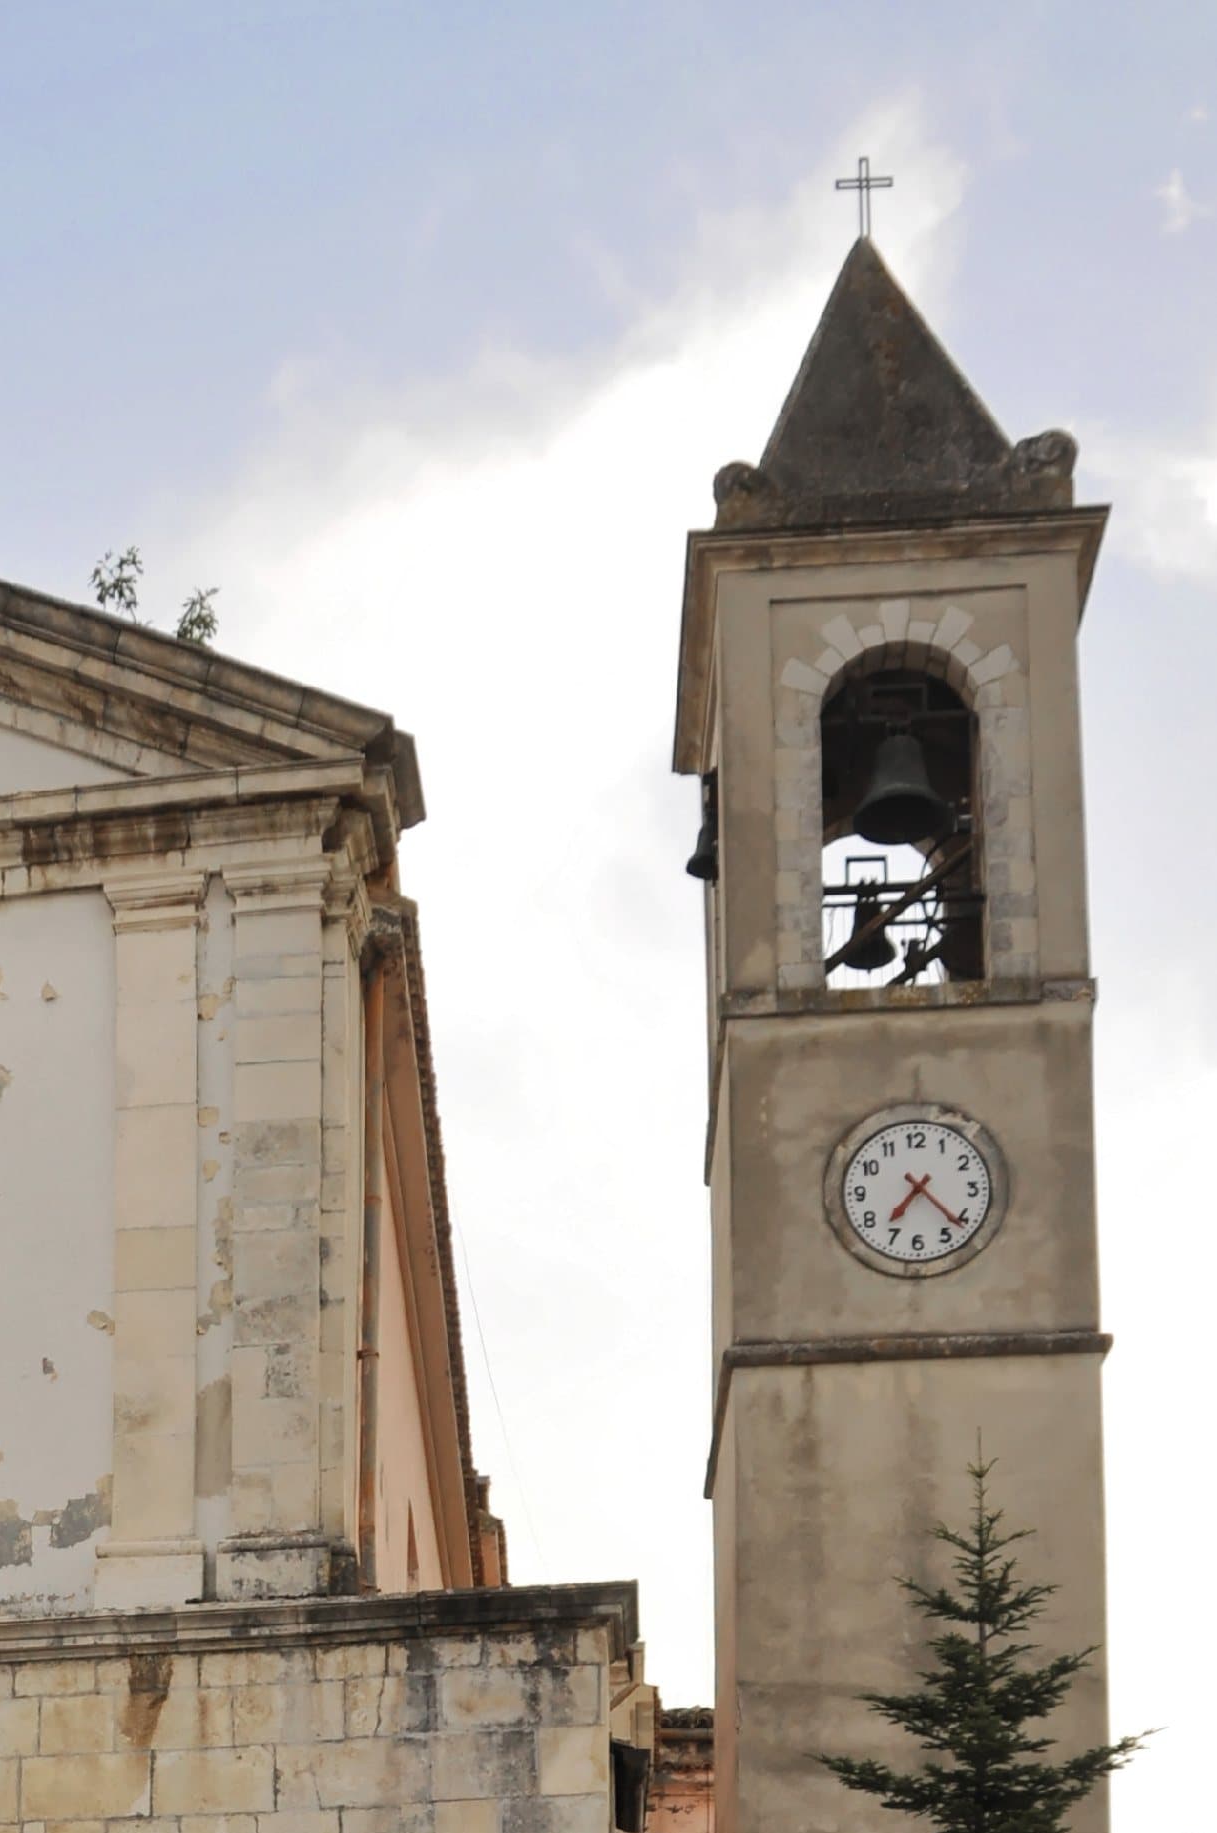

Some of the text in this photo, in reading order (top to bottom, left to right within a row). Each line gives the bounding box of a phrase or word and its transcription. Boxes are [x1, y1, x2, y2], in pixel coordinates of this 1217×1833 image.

[906, 1132, 926, 1149] 12
[939, 1139, 945, 1154] 1
[882, 1141, 895, 1157] 11
[862, 1160, 879, 1176] 10
[958, 1155, 969, 1171] 2
[854, 1185, 866, 1202] 9
[967, 1181, 979, 1197] 3
[864, 1211, 876, 1228] 8
[958, 1208, 969, 1224] 4
[888, 1228, 901, 1246] 7
[912, 1234, 925, 1251] 6
[940, 1228, 952, 1243] 5
